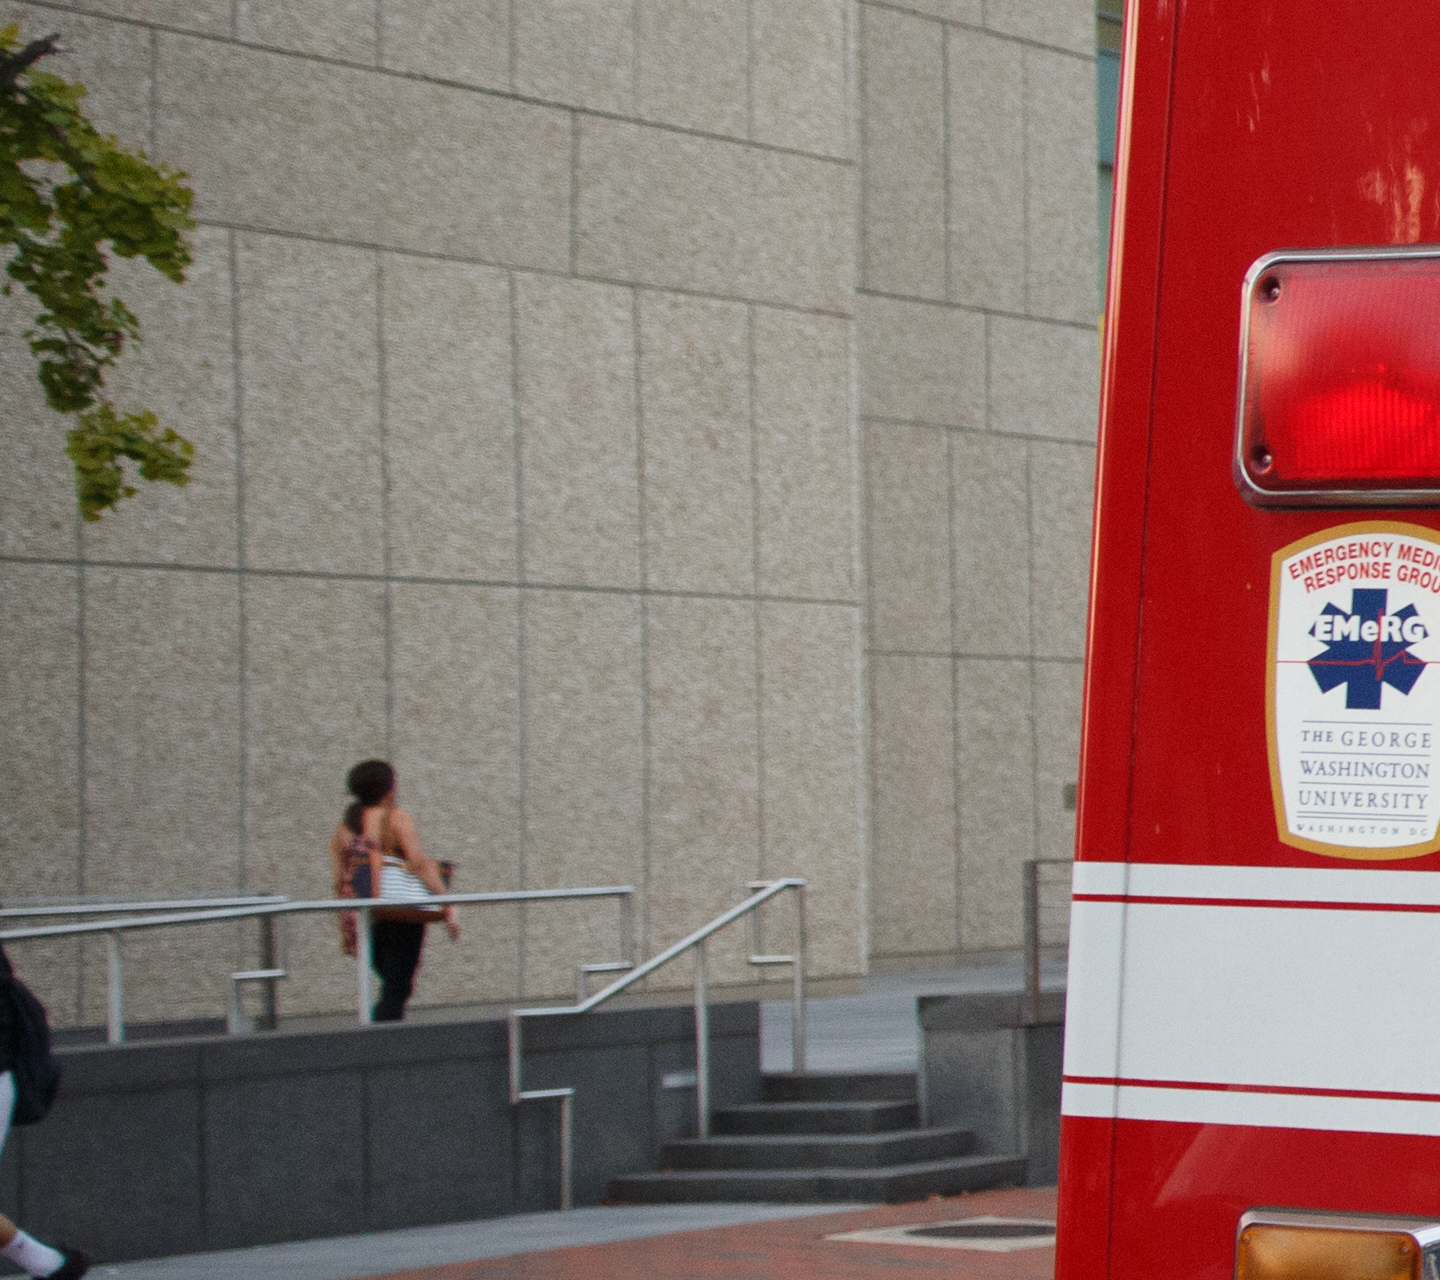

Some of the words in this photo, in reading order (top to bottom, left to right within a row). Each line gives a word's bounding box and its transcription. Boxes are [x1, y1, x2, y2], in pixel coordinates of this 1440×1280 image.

[1288, 541, 1393, 580] EMERGENCY
[1304, 563, 1391, 594] RESPONSE
[1314, 614, 1425, 642] EMeRG
[1300, 730, 1334, 743] THE
[1341, 731, 1432, 749] GEORGE
[1300, 760, 1430, 780] WASHINGTON
[1298, 790, 1429, 809] UNIVERSITY
[1296, 824, 1400, 836] WASHINGTON
[1409, 827, 1428, 836] DC
